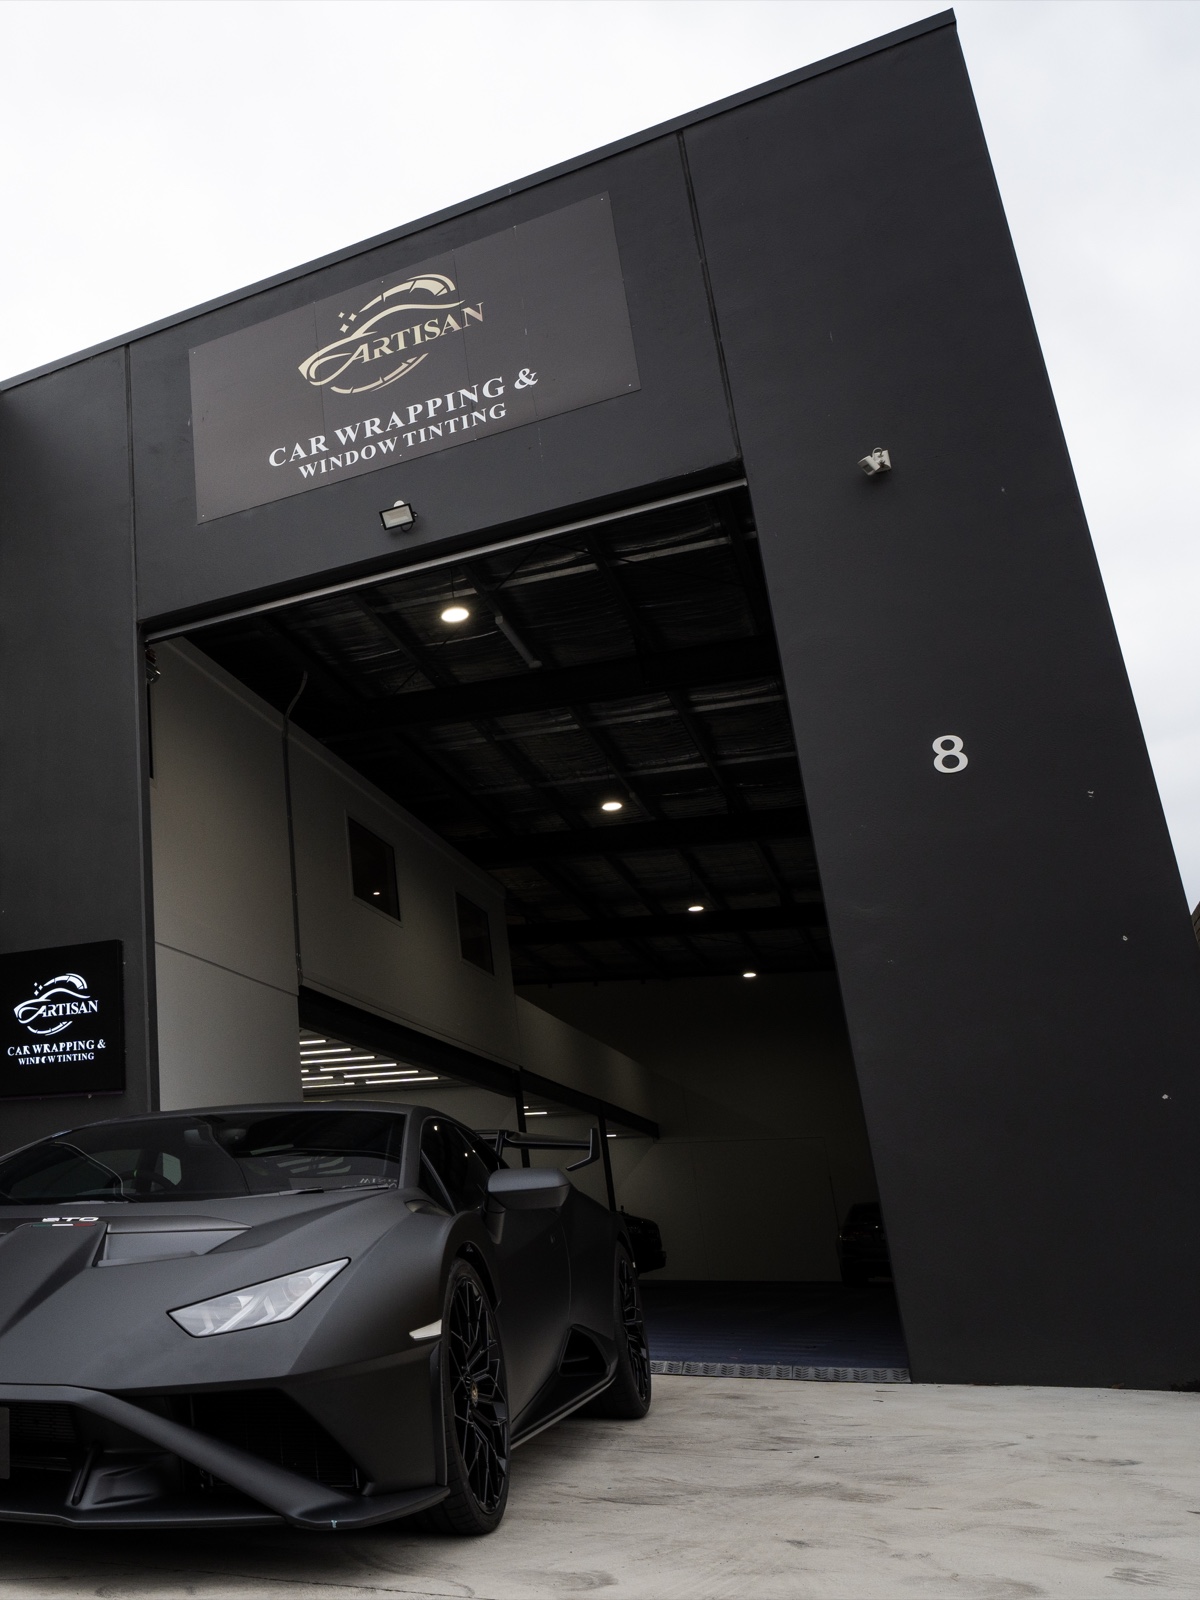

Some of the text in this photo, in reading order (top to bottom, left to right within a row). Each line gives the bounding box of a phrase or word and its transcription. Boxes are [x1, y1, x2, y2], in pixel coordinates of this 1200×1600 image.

[351, 302, 484, 363] ARTISAN
[269, 367, 538, 467] CAR WRAPPING &
[299, 402, 507, 478] WINDOW TINTING
[932, 735, 969, 773] 8
[37, 1000, 99, 1018] ARTISAN
[7, 1038, 106, 1056] CAR WRAPPING &
[57, 1052, 95, 1063] TINTING
